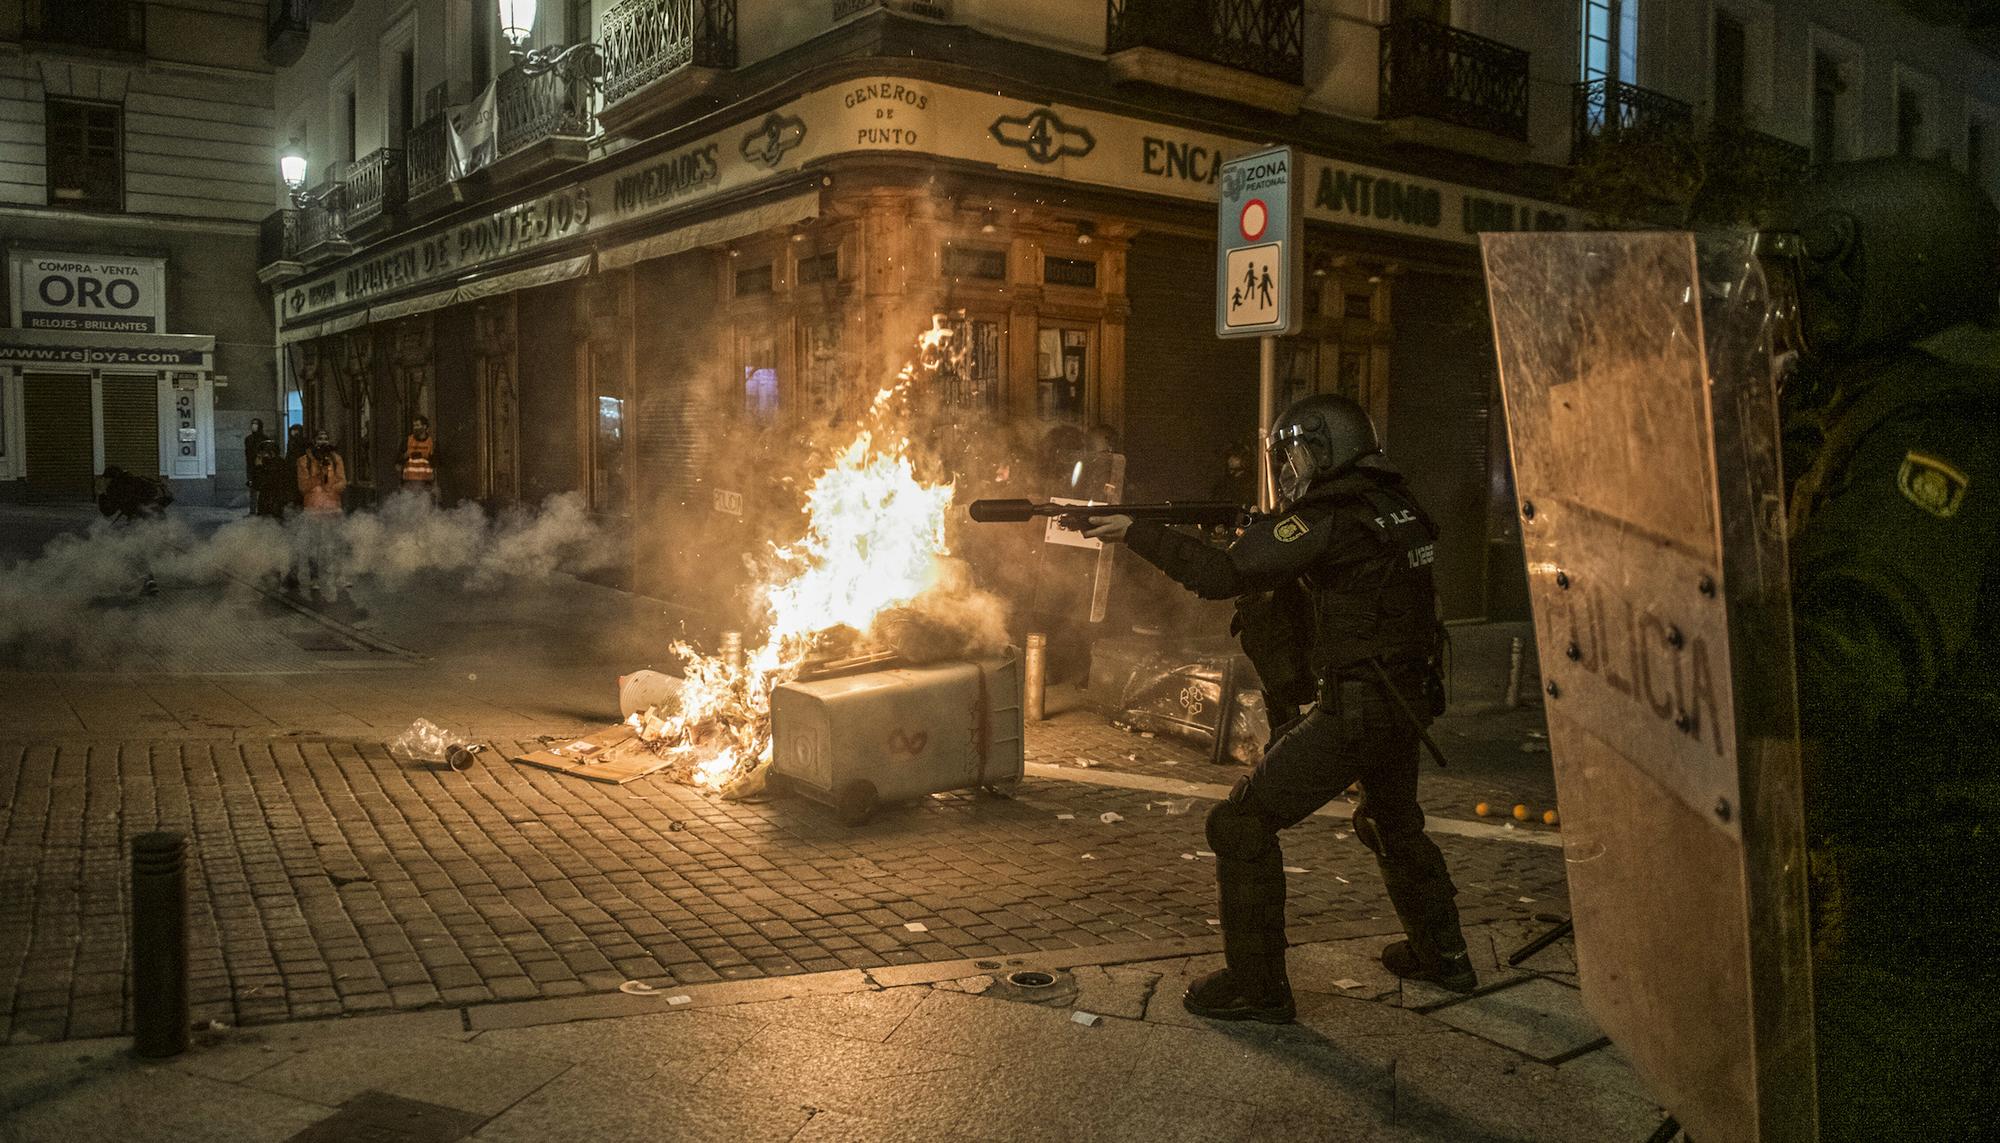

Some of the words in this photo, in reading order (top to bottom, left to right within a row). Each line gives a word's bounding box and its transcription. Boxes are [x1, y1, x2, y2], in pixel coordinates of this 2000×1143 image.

[845, 83, 928, 110] GENEROS
[876, 109, 894, 119] DE
[858, 129, 917, 146] PUNTO
[1142, 136, 1222, 185] ENCA
[1246, 160, 1287, 182] ZONA
[1246, 178, 1287, 192] PEATONAL
[423, 235, 450, 273] DE
[458, 187, 593, 262] PONTEJOS
[614, 143, 720, 213] NOVEDADES
[38, 261, 91, 274] COMPRA
[101, 265, 139, 276] VENTA
[38, 275, 140, 310] ORO
[32, 318, 77, 329] RELOJES
[84, 320, 148, 332] BRILLANTES
[0, 348, 180, 364] www.rejoya.com
